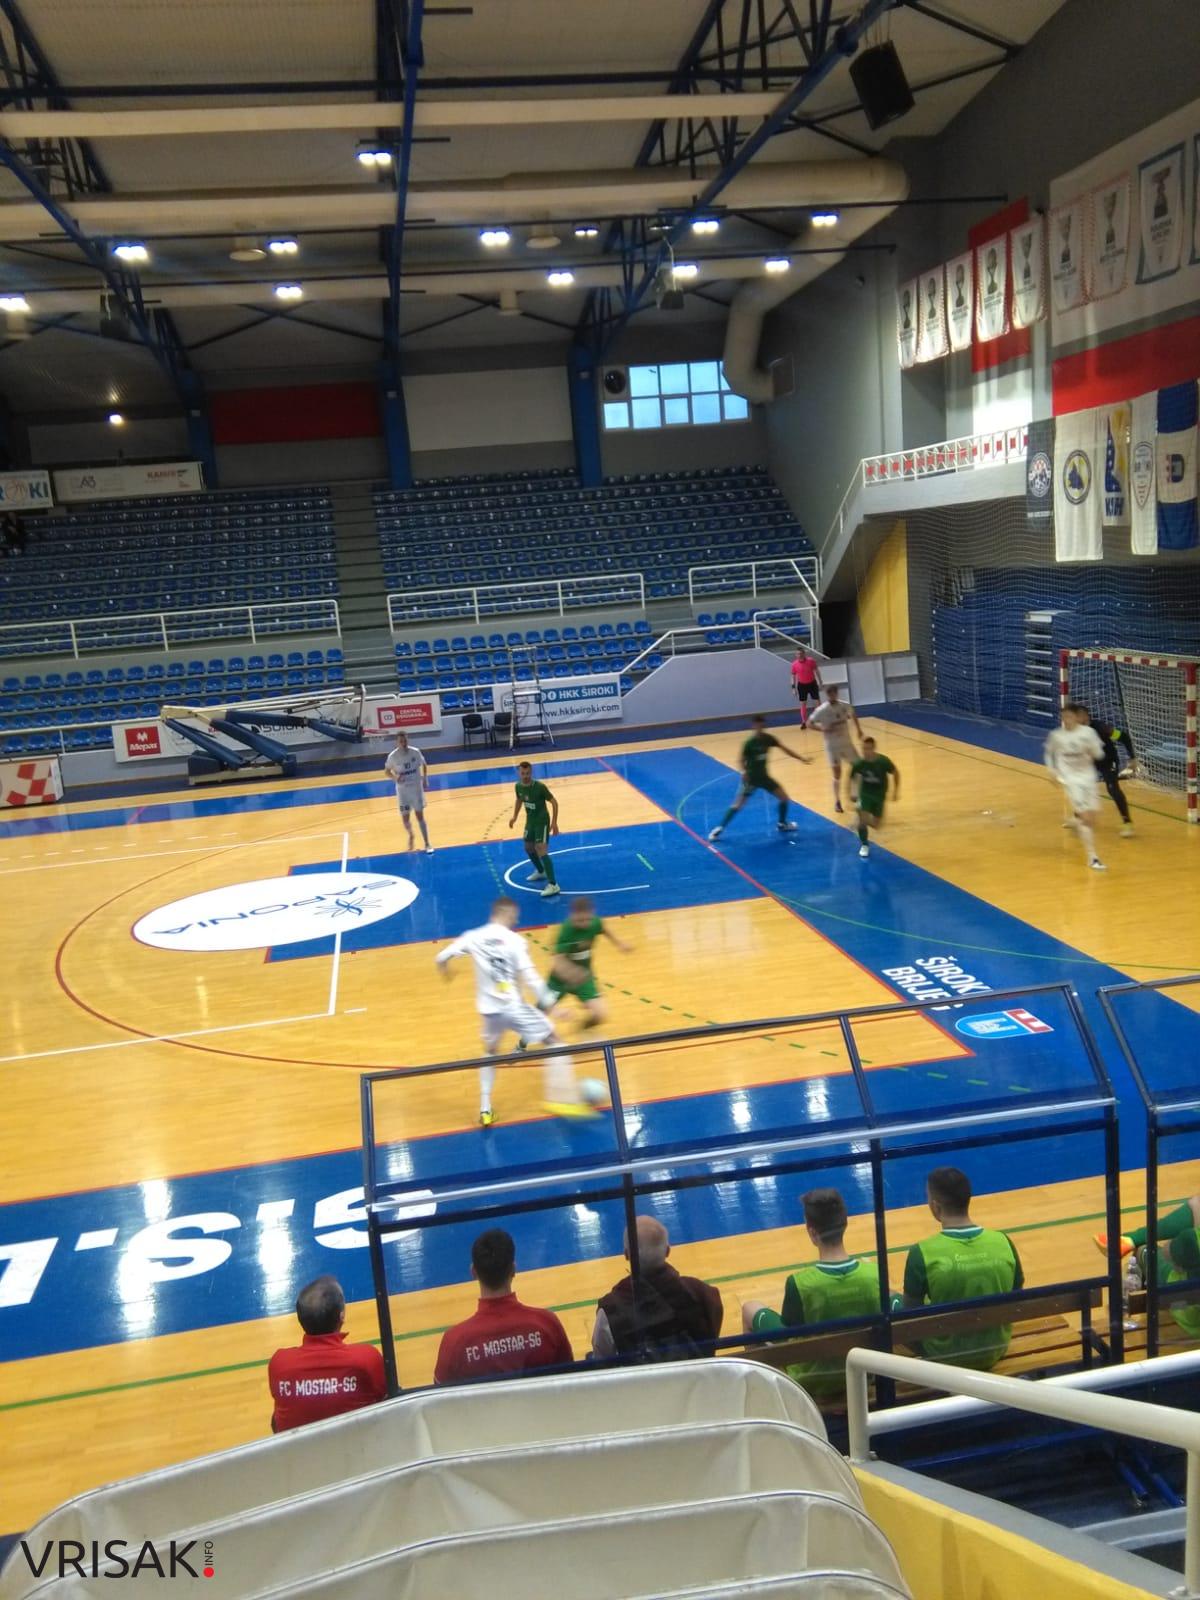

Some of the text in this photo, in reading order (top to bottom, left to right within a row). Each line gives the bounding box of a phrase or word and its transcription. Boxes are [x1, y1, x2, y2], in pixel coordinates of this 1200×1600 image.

[559, 685, 614, 700] HKK ŠIROKI
[130, 743, 158, 751] Mepas
[151, 879, 398, 935] SAPONIA
[466, 1331, 542, 1362] FC MOSTAR-SG
[279, 1376, 357, 1396] FC MOSTAR-SG
